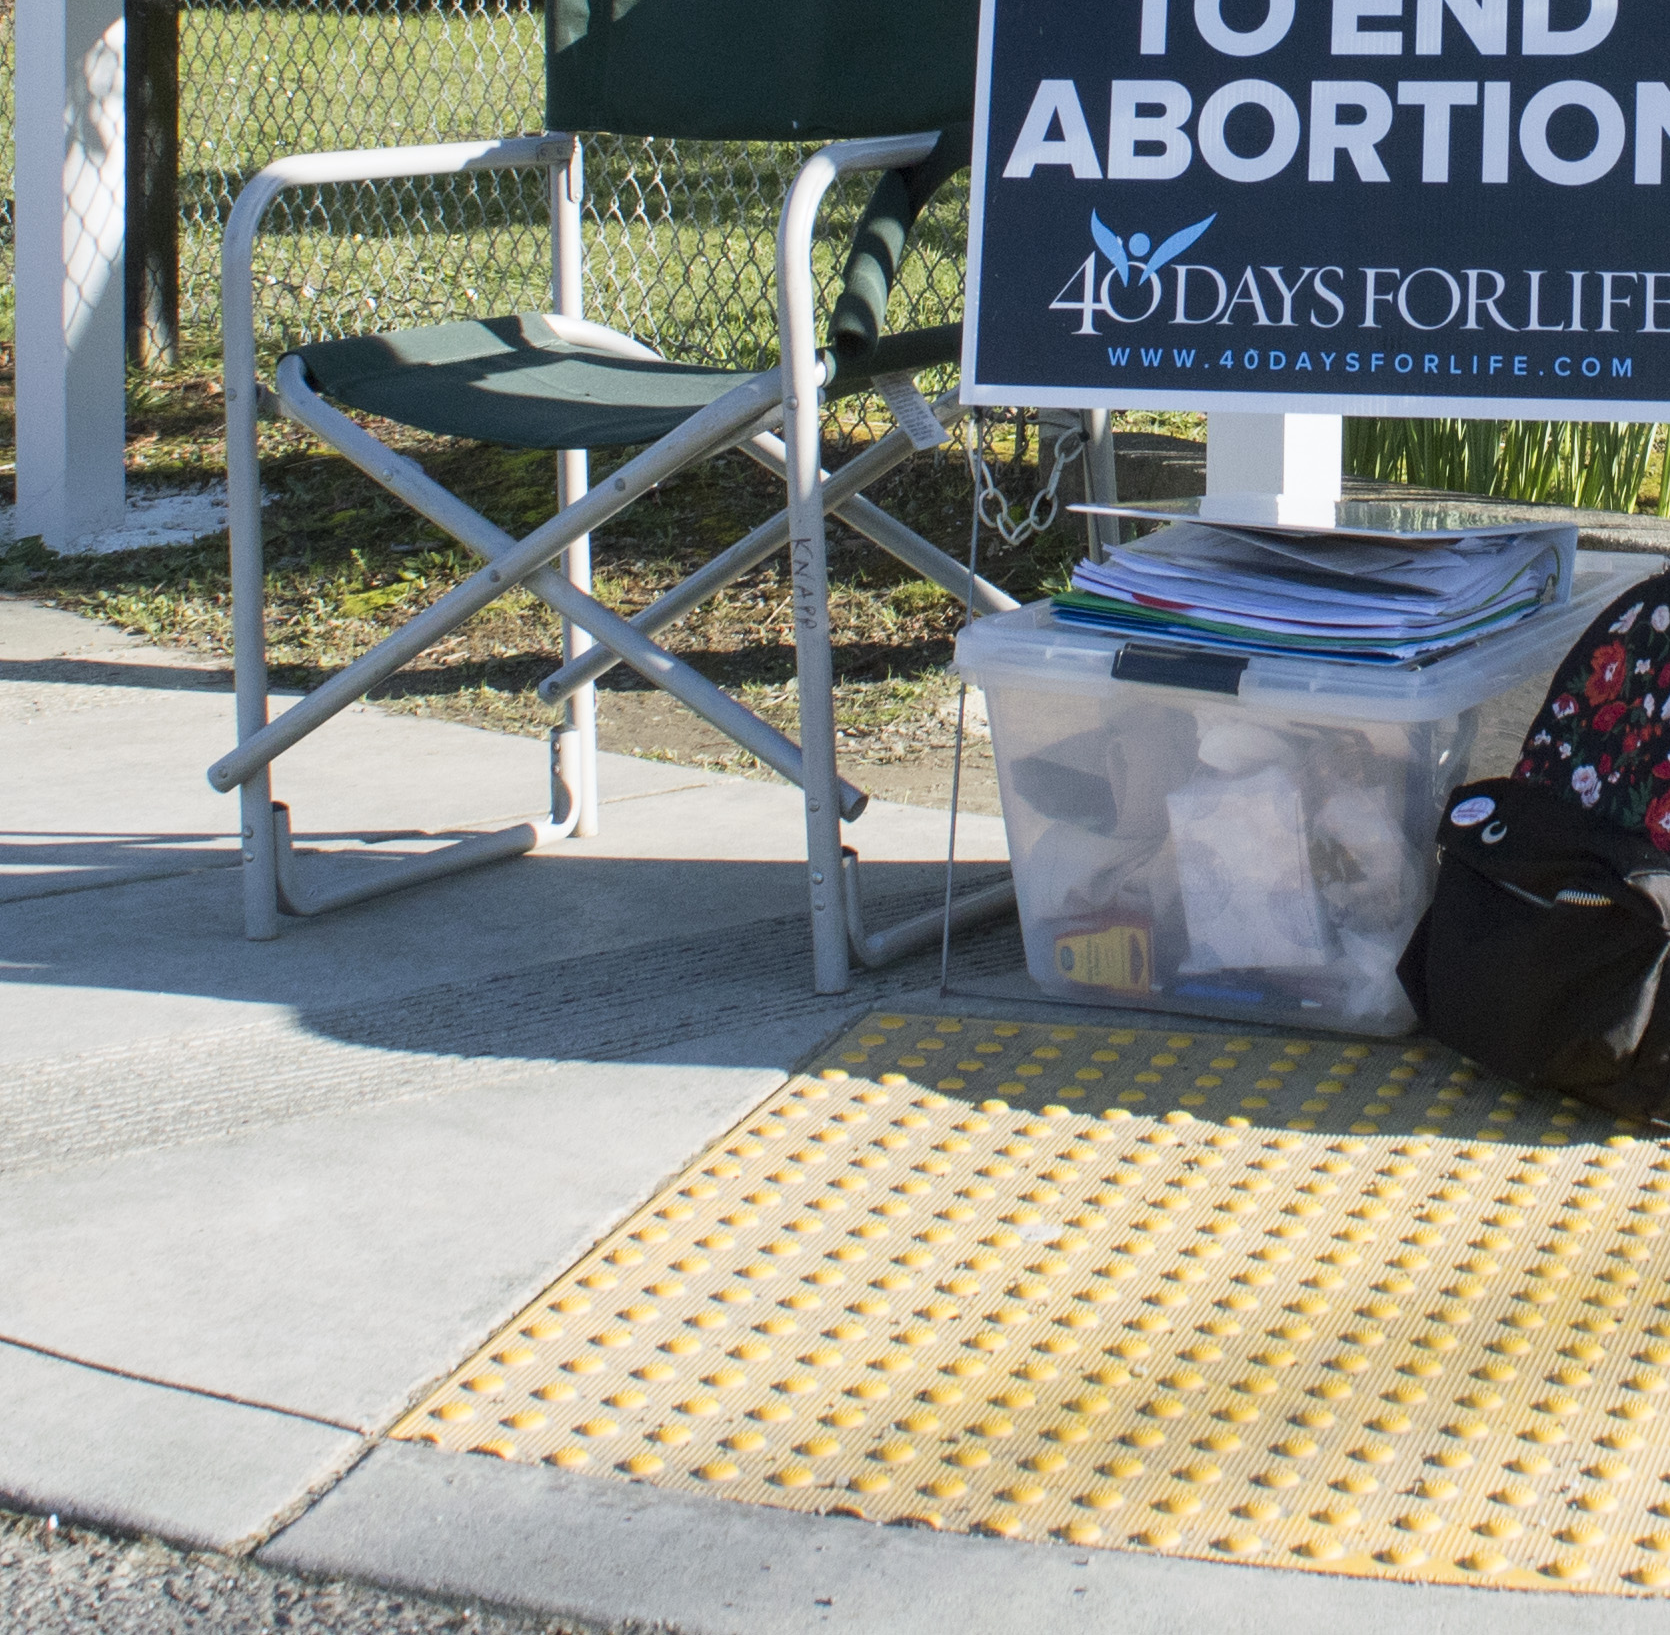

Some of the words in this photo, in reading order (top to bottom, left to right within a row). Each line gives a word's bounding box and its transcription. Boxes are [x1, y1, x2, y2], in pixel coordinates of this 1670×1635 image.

[1167, 264, 1347, 329] DAYS
[1358, 265, 1522, 332] FOR
[1106, 346, 1635, 379] WWW.40DAYSFORLIFE.COM
